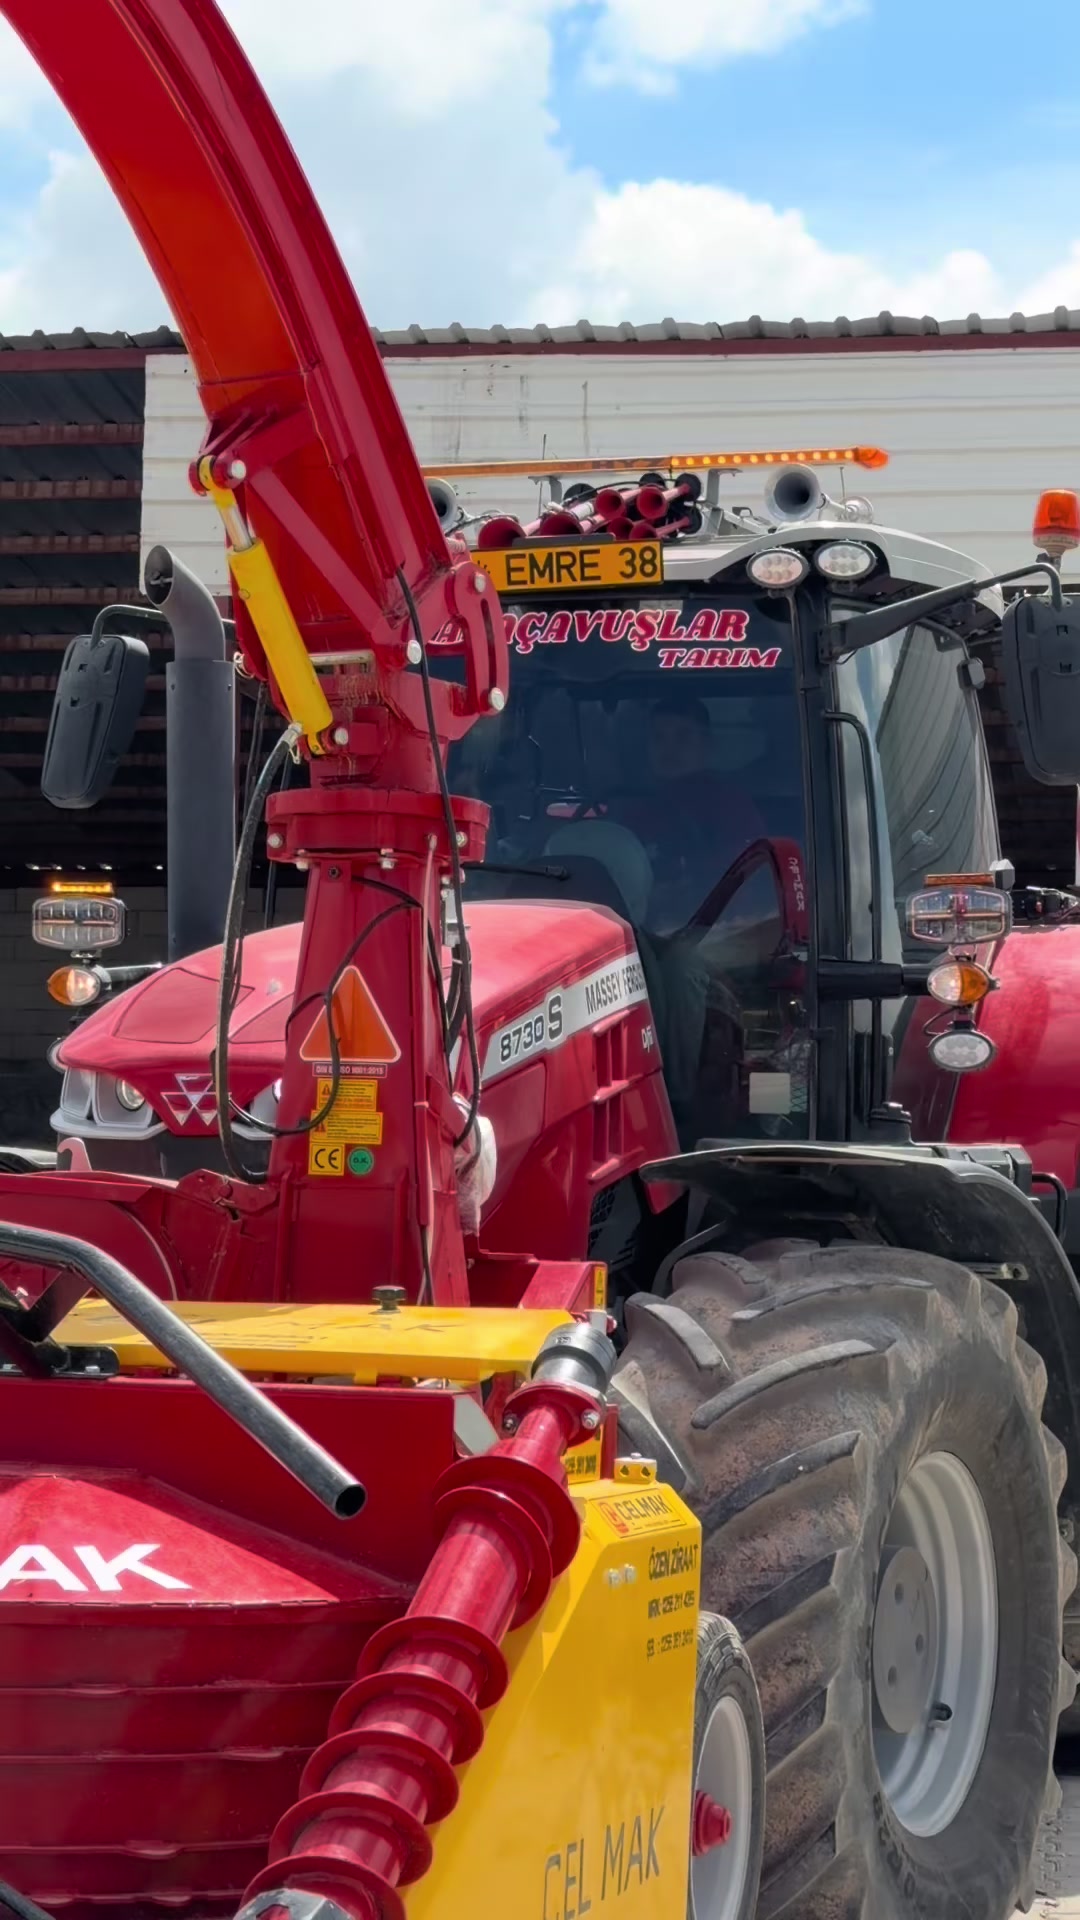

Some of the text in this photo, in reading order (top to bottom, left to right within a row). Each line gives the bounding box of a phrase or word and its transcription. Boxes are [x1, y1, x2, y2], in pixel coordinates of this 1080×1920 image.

[505, 546, 658, 586] EMRE 38
[658, 648, 781, 669] TARIM
[585, 970, 622, 1016] MASSEY
[500, 993, 564, 1064] 8730 S
[600, 1805, 666, 1901] MAK
